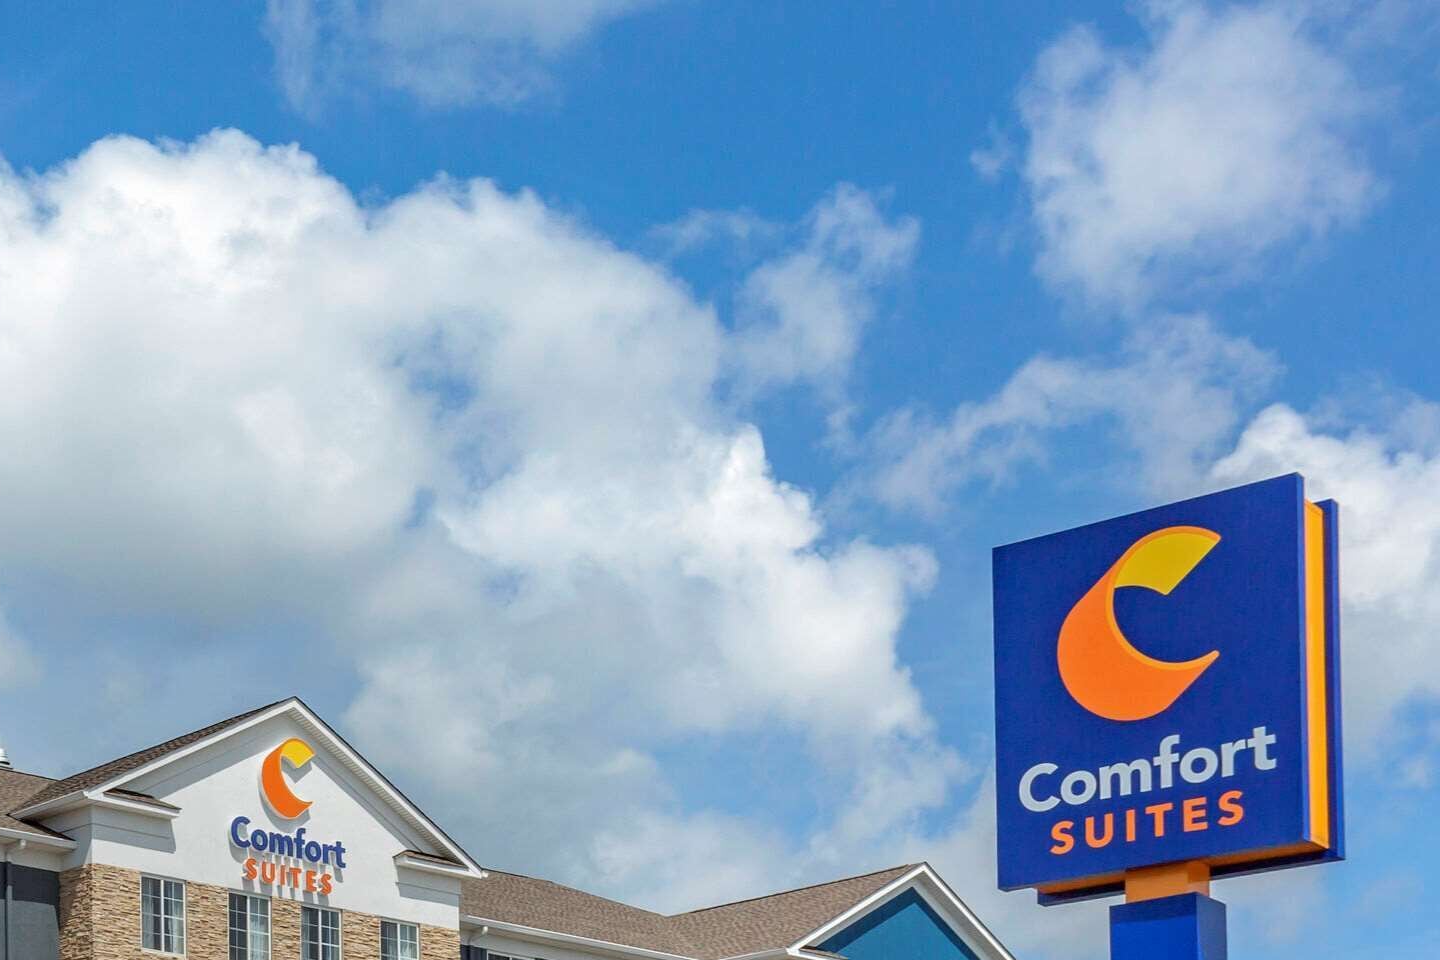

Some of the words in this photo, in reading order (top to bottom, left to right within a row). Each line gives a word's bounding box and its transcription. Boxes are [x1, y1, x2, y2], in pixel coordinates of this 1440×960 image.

[1018, 726, 1278, 812] Comfort
[231, 816, 346, 868] Comfort
[1049, 790, 1245, 855] SUITES
[244, 858, 333, 896] SUITES
